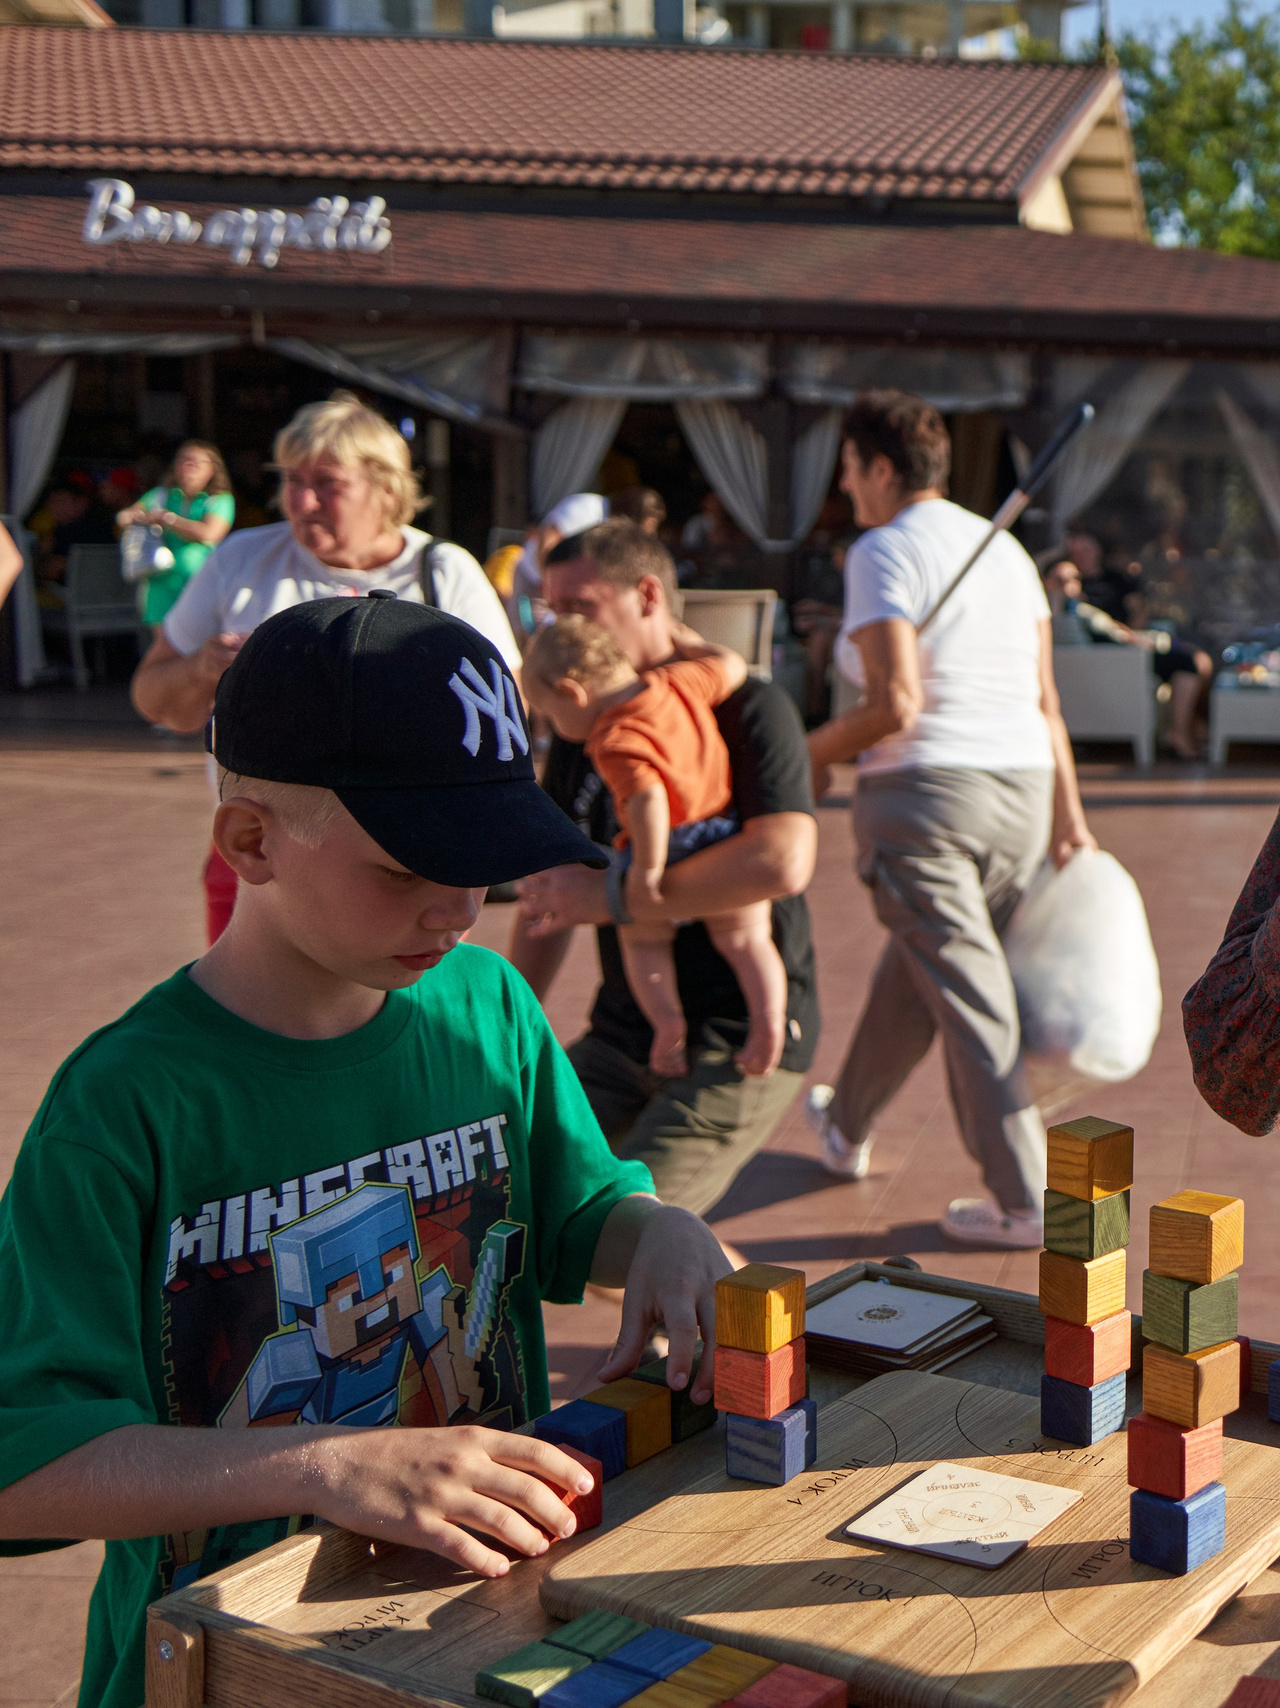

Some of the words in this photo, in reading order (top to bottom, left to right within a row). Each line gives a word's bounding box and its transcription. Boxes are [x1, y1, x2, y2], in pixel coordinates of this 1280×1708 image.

[82, 177, 203, 246] Bon
[448, 656, 530, 761] NY
[164, 1113, 511, 1288] MINECRAFT
[1024, 1442, 1105, 1467] ИГРОК
[801, 1458, 870, 1496] ИГРОК
[981, 1545, 992, 1553] 5
[1070, 1535, 1131, 1579] ИГРОК
[810, 1570, 901, 1603] ИГРОК
